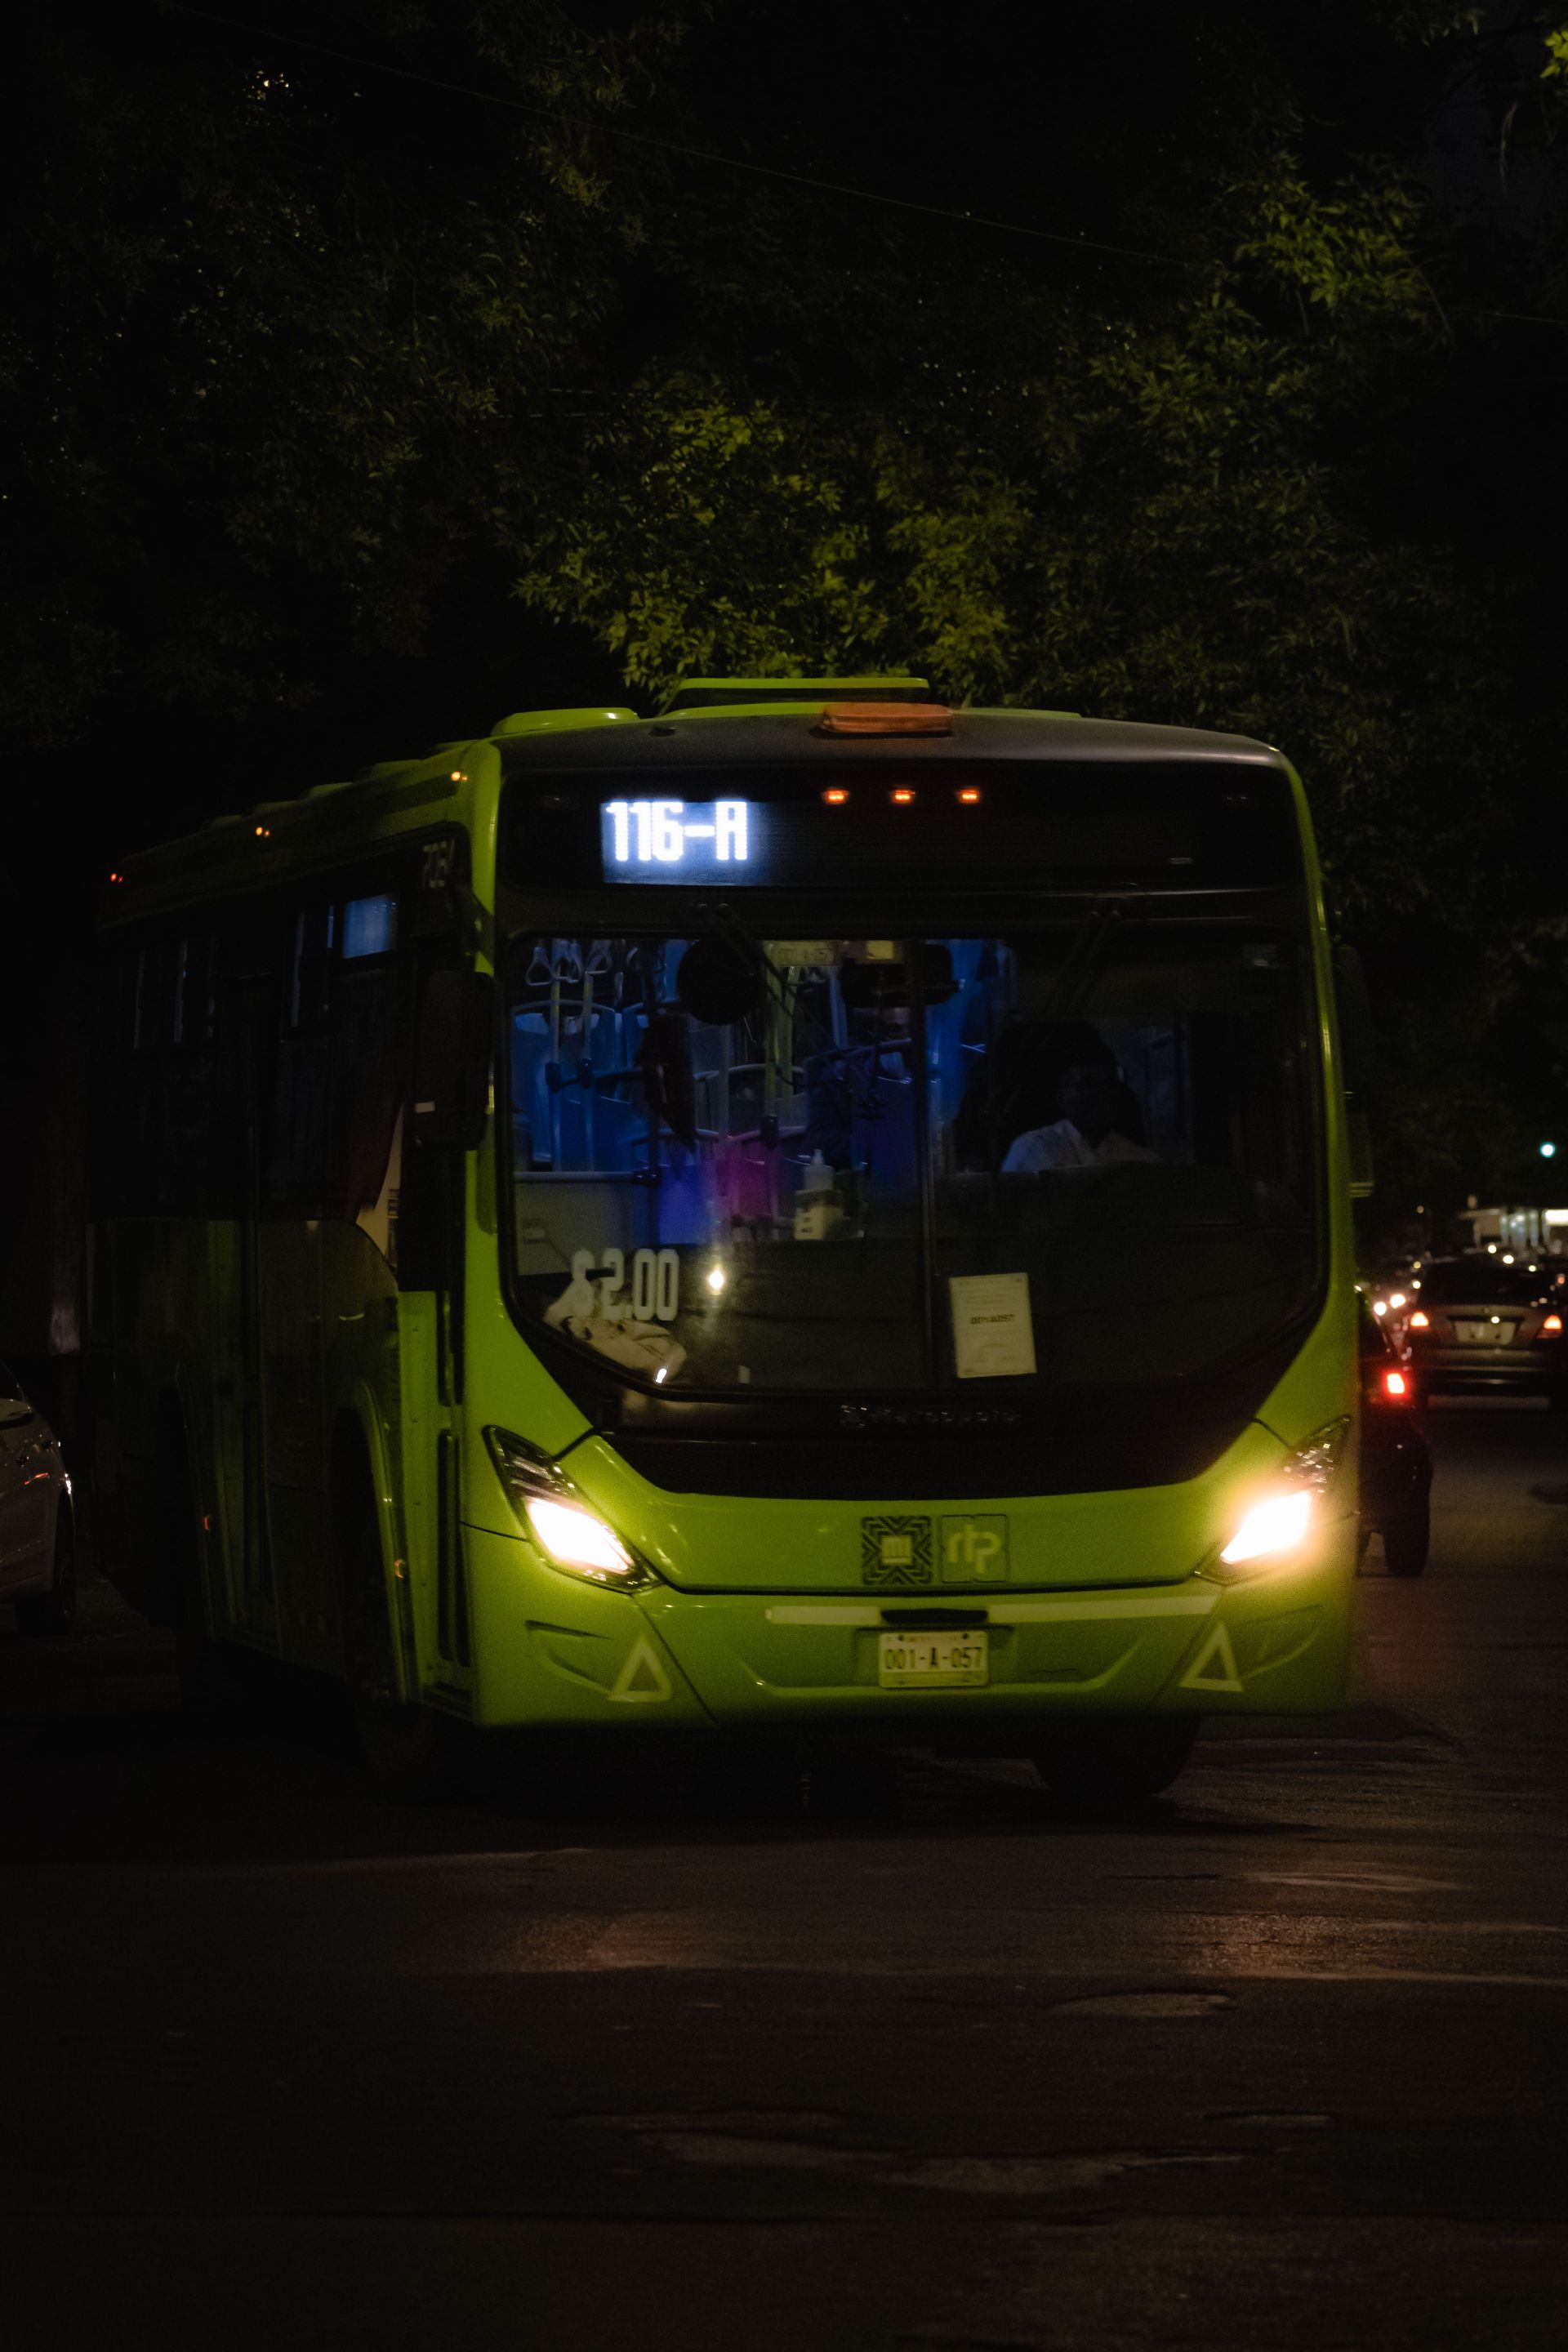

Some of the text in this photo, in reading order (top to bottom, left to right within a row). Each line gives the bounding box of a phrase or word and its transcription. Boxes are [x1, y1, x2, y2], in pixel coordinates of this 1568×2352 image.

[606, 801, 747, 861] 116-A
[572, 1248, 679, 1321] $2.00
[884, 1646, 982, 1669] 001-A-057
